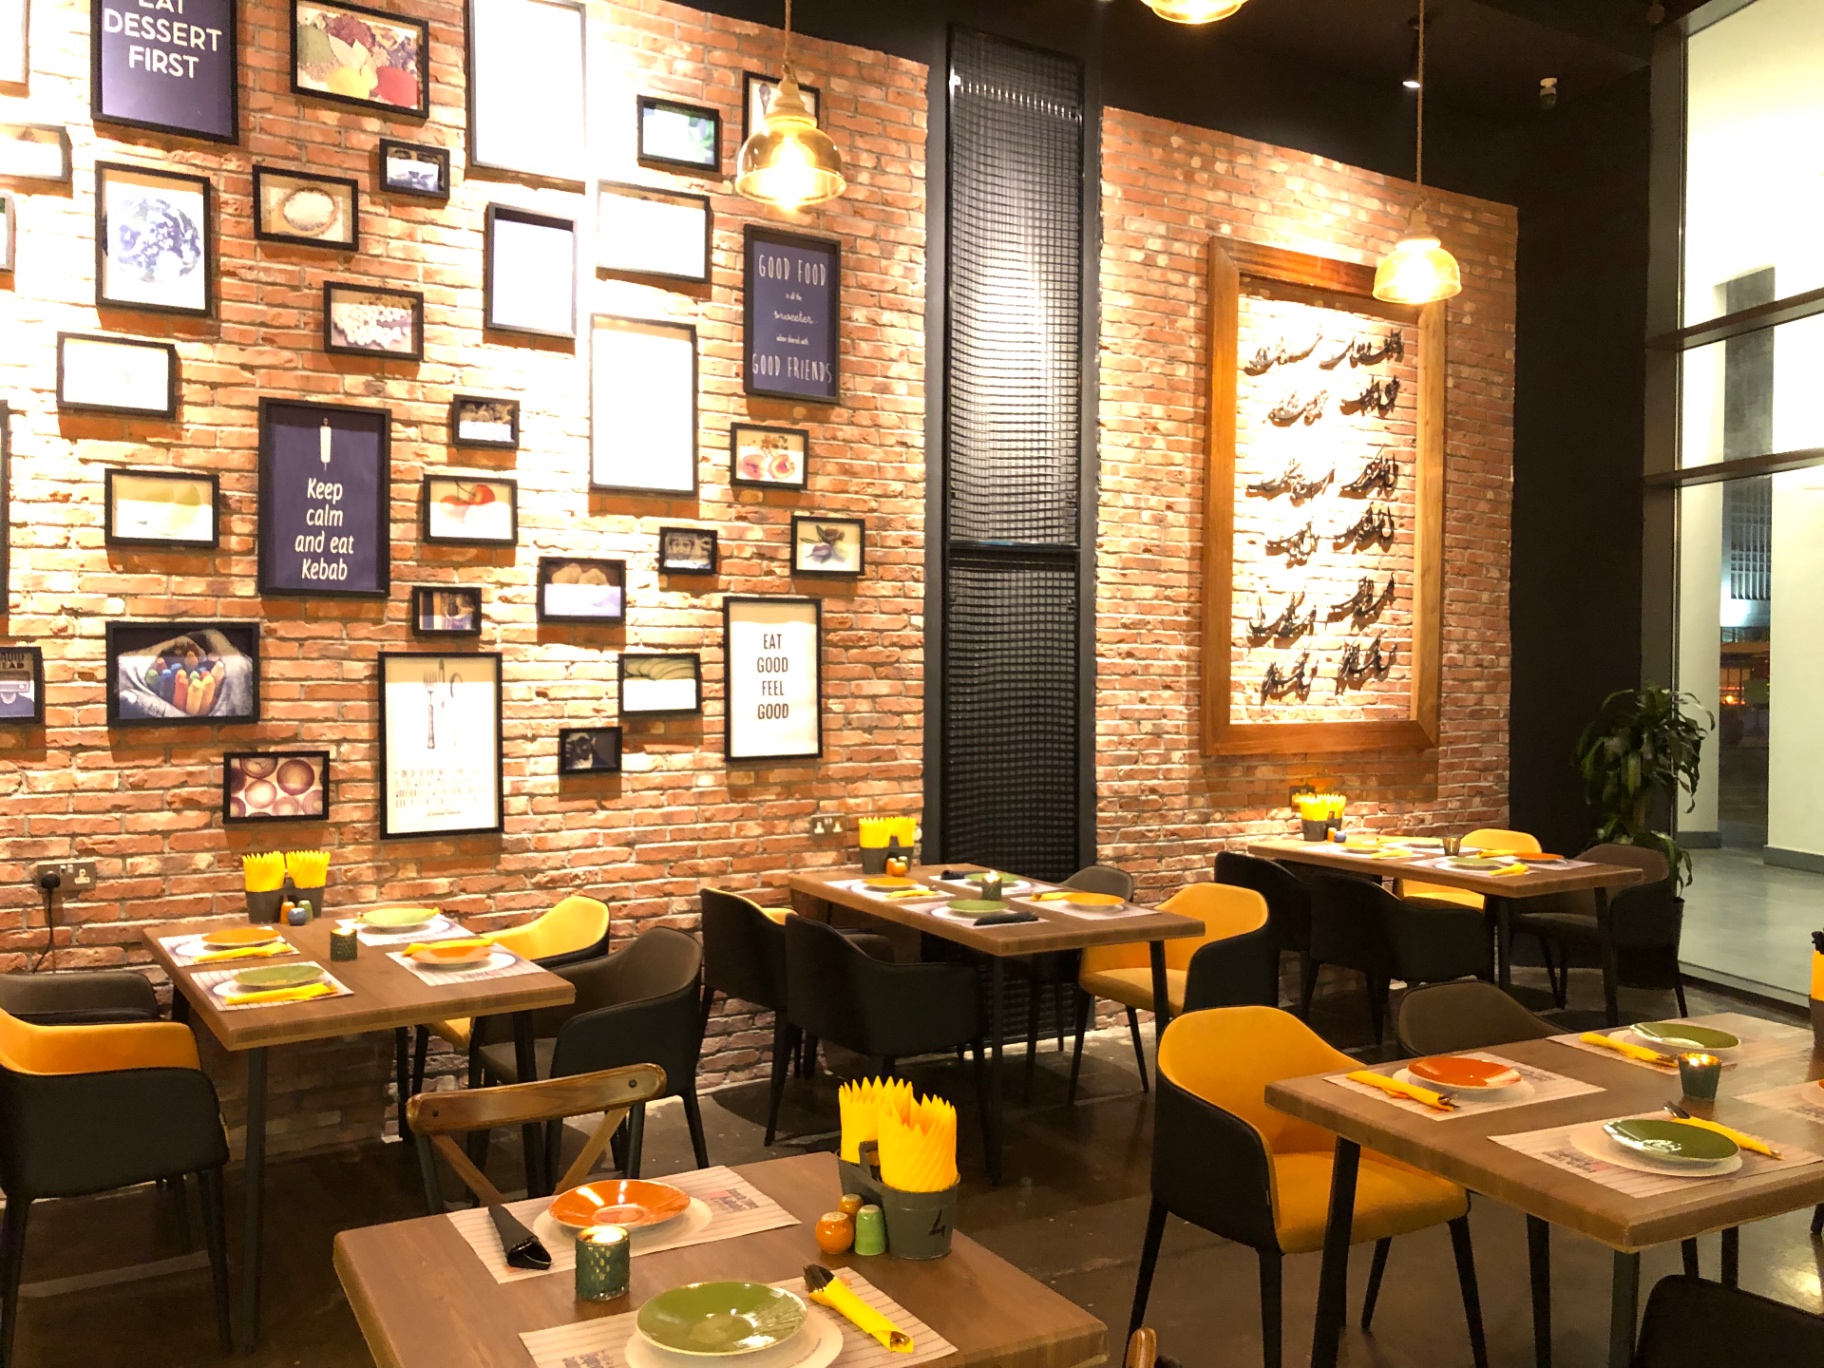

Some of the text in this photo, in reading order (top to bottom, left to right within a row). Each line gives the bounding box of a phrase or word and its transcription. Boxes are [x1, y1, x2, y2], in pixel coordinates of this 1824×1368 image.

[103, 8, 223, 52] DESSERT
[128, 45, 200, 79] FIRST
[758, 254, 827, 286] GOOD FOOD
[752, 353, 833, 384] GOOD FRIENDS
[307, 477, 343, 505] Keep
[306, 503, 344, 527] calm
[294, 530, 355, 555] and eat
[301, 557, 348, 581] Kebab
[763, 633, 782, 650] EAT
[756, 656, 789, 673] GOOD
[761, 680, 785, 696] FEEL
[757, 703, 790, 720] GOOD
[928, 1208, 946, 1238] 4
